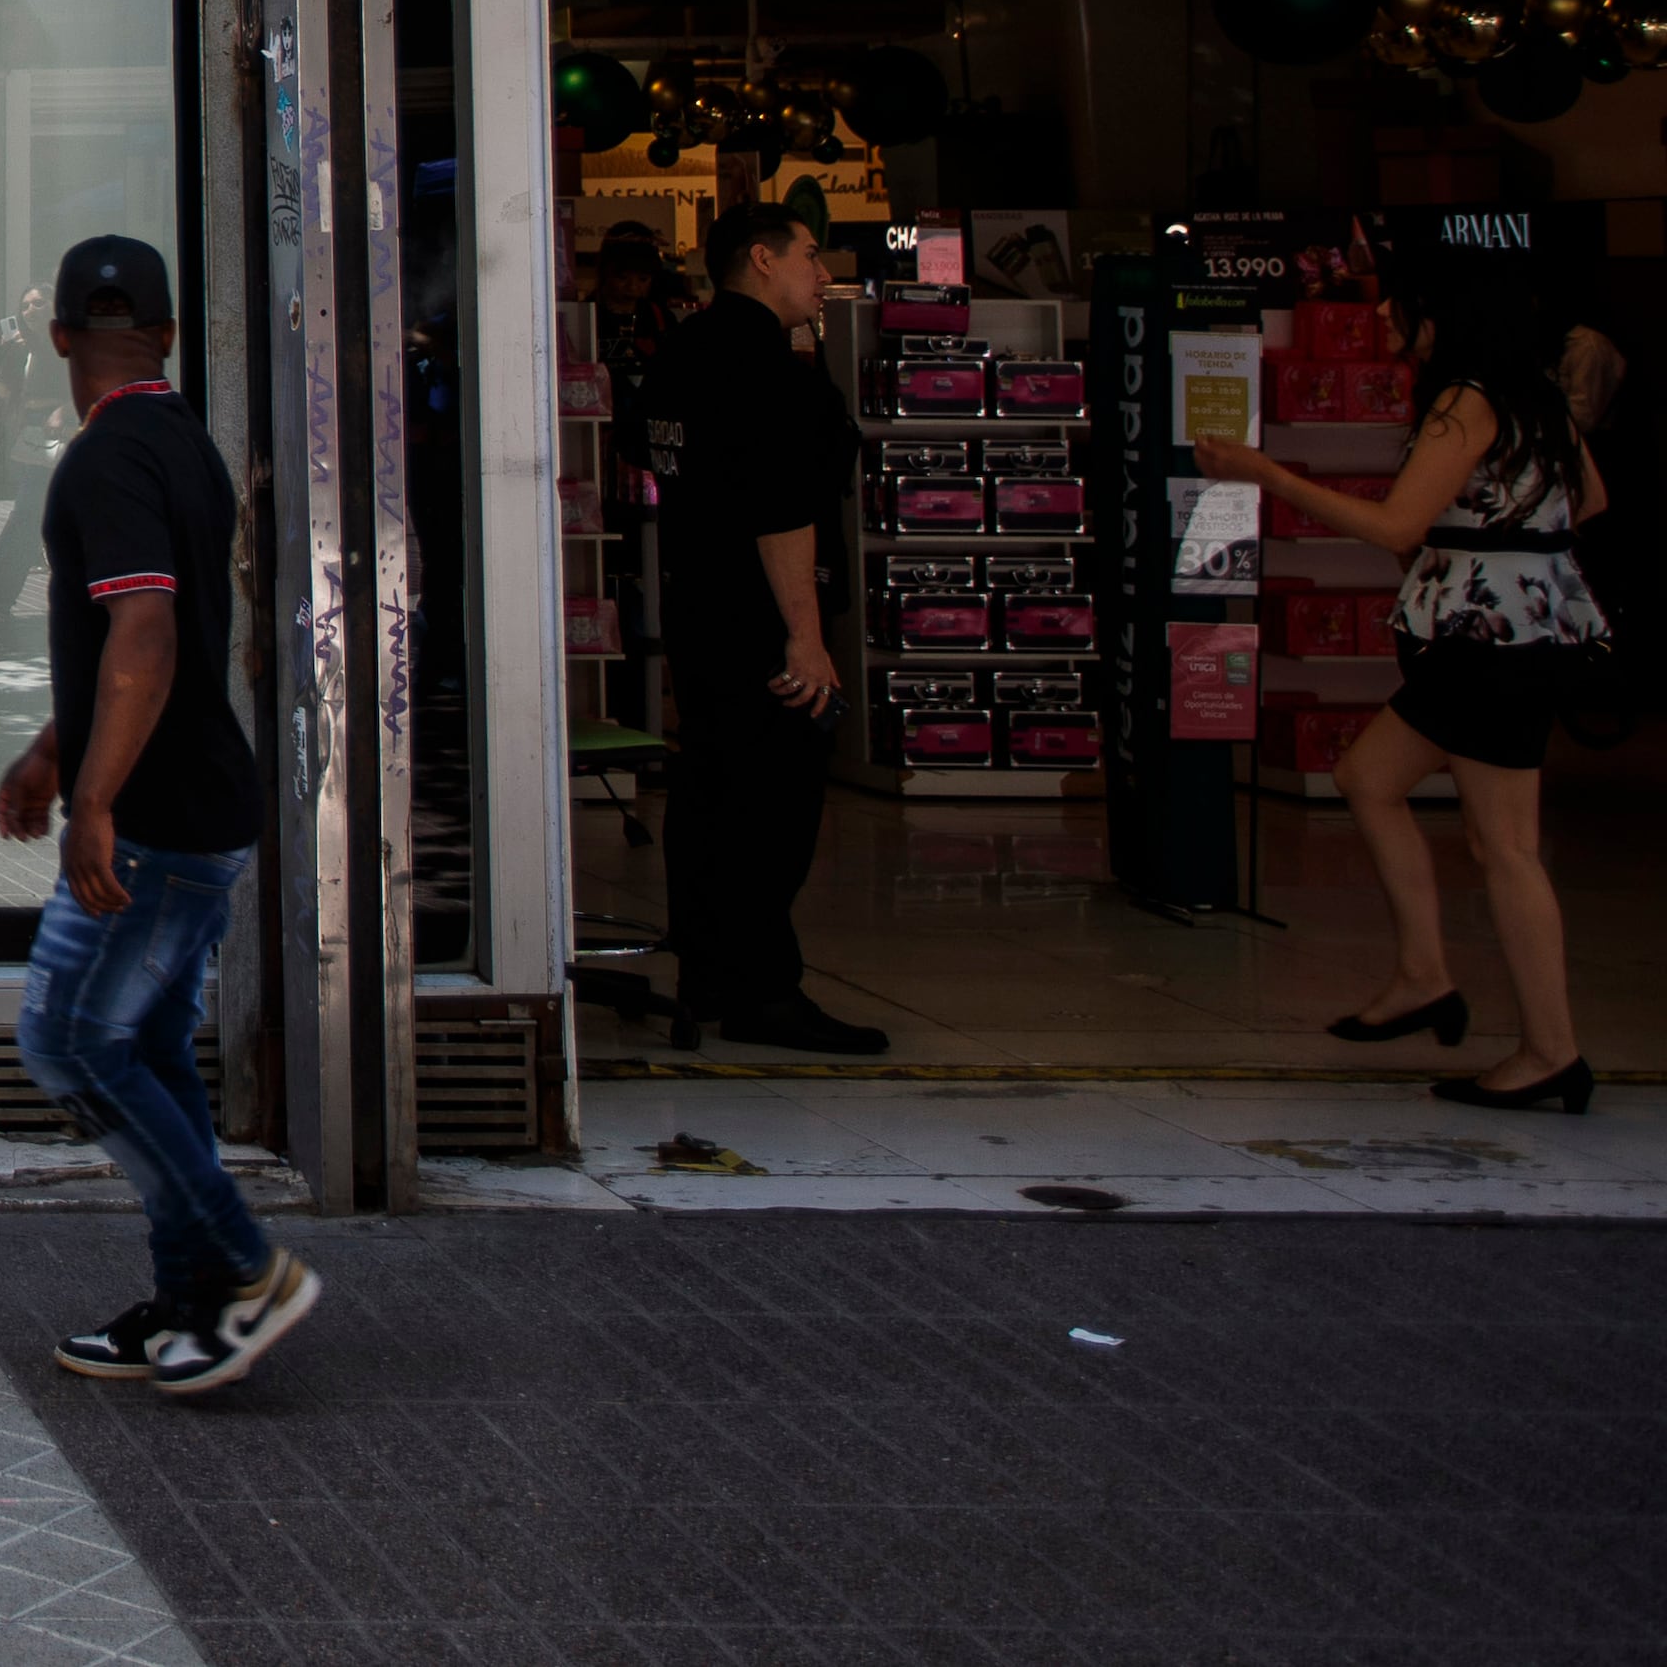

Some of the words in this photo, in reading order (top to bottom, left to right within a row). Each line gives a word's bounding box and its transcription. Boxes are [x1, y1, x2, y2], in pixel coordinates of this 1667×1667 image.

[885, 224, 917, 251] CHA
[1439, 212, 1531, 249] ARMANI
[1203, 256, 1285, 279] 13.990
